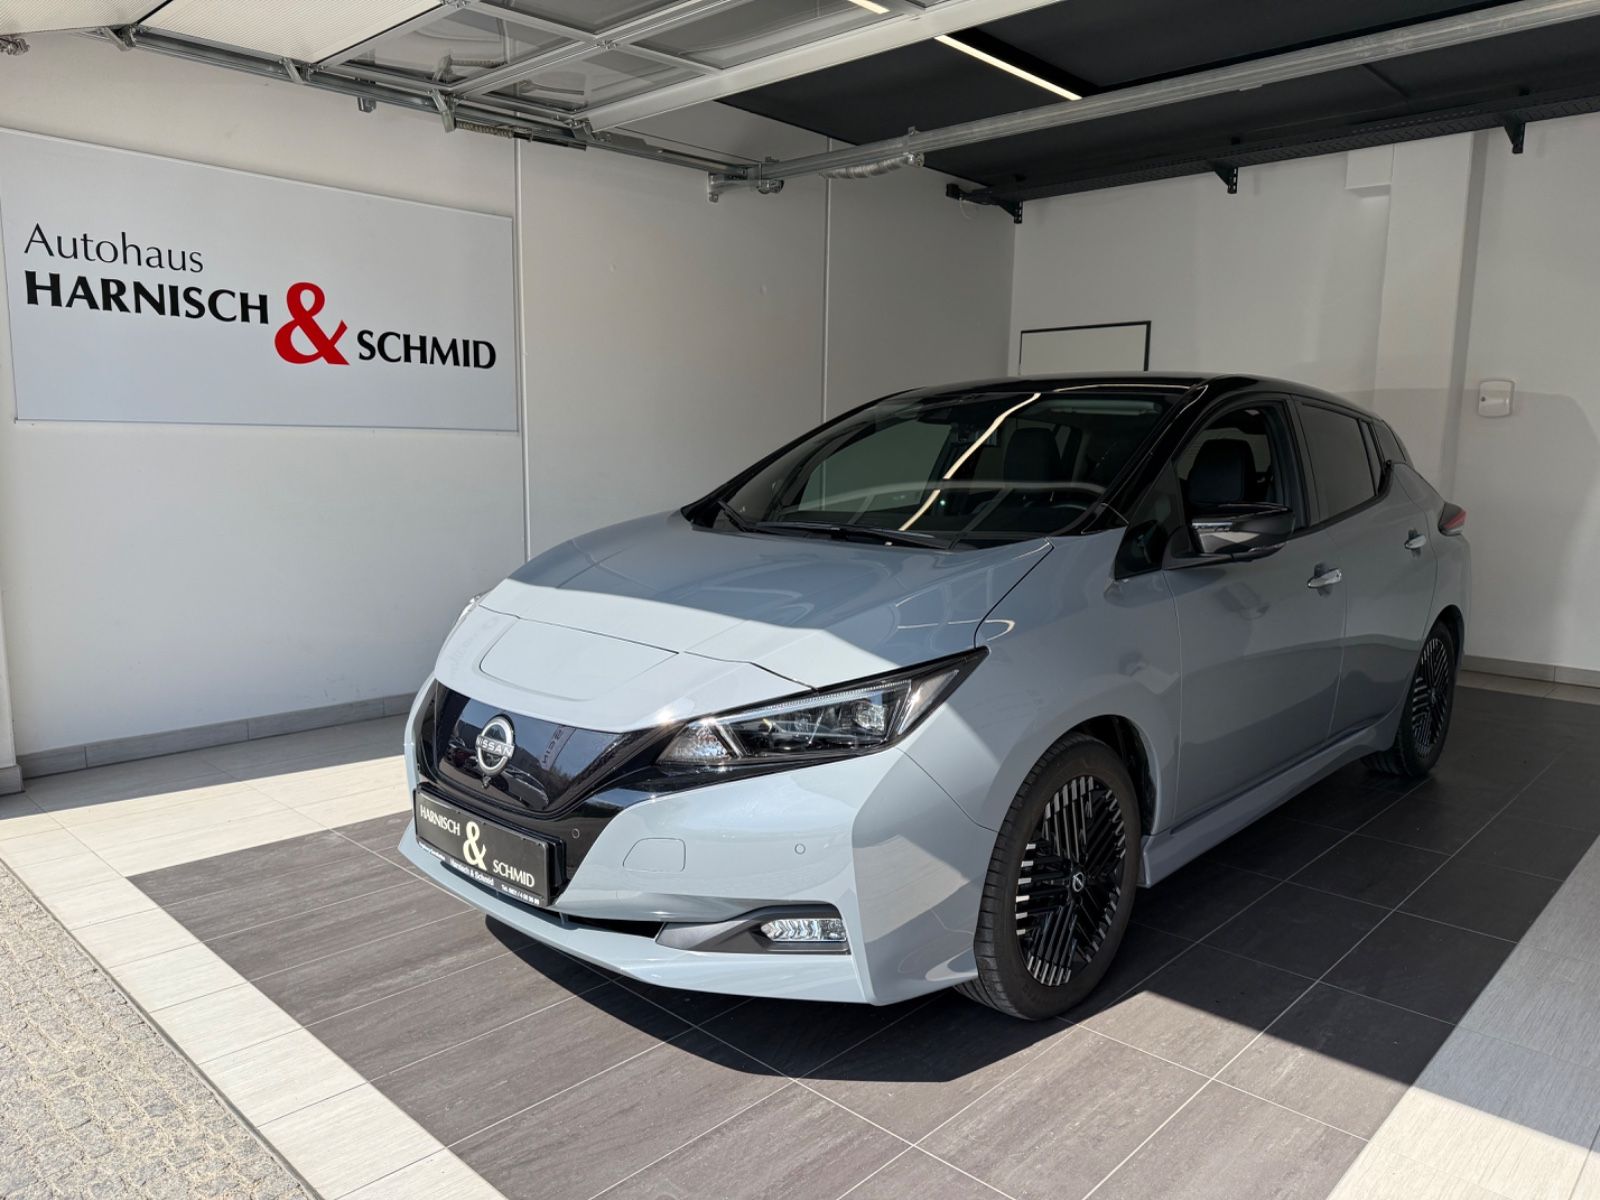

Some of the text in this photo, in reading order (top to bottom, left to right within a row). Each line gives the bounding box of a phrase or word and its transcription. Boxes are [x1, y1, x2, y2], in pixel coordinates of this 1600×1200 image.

[25, 223, 204, 273] Autohaus
[25, 271, 497, 370] HARNISCH & SCHMID
[477, 736, 514, 758] NISSAN
[420, 804, 461, 836] HARNISCH
[462, 821, 487, 871] &
[493, 859, 535, 888] SCHMID
